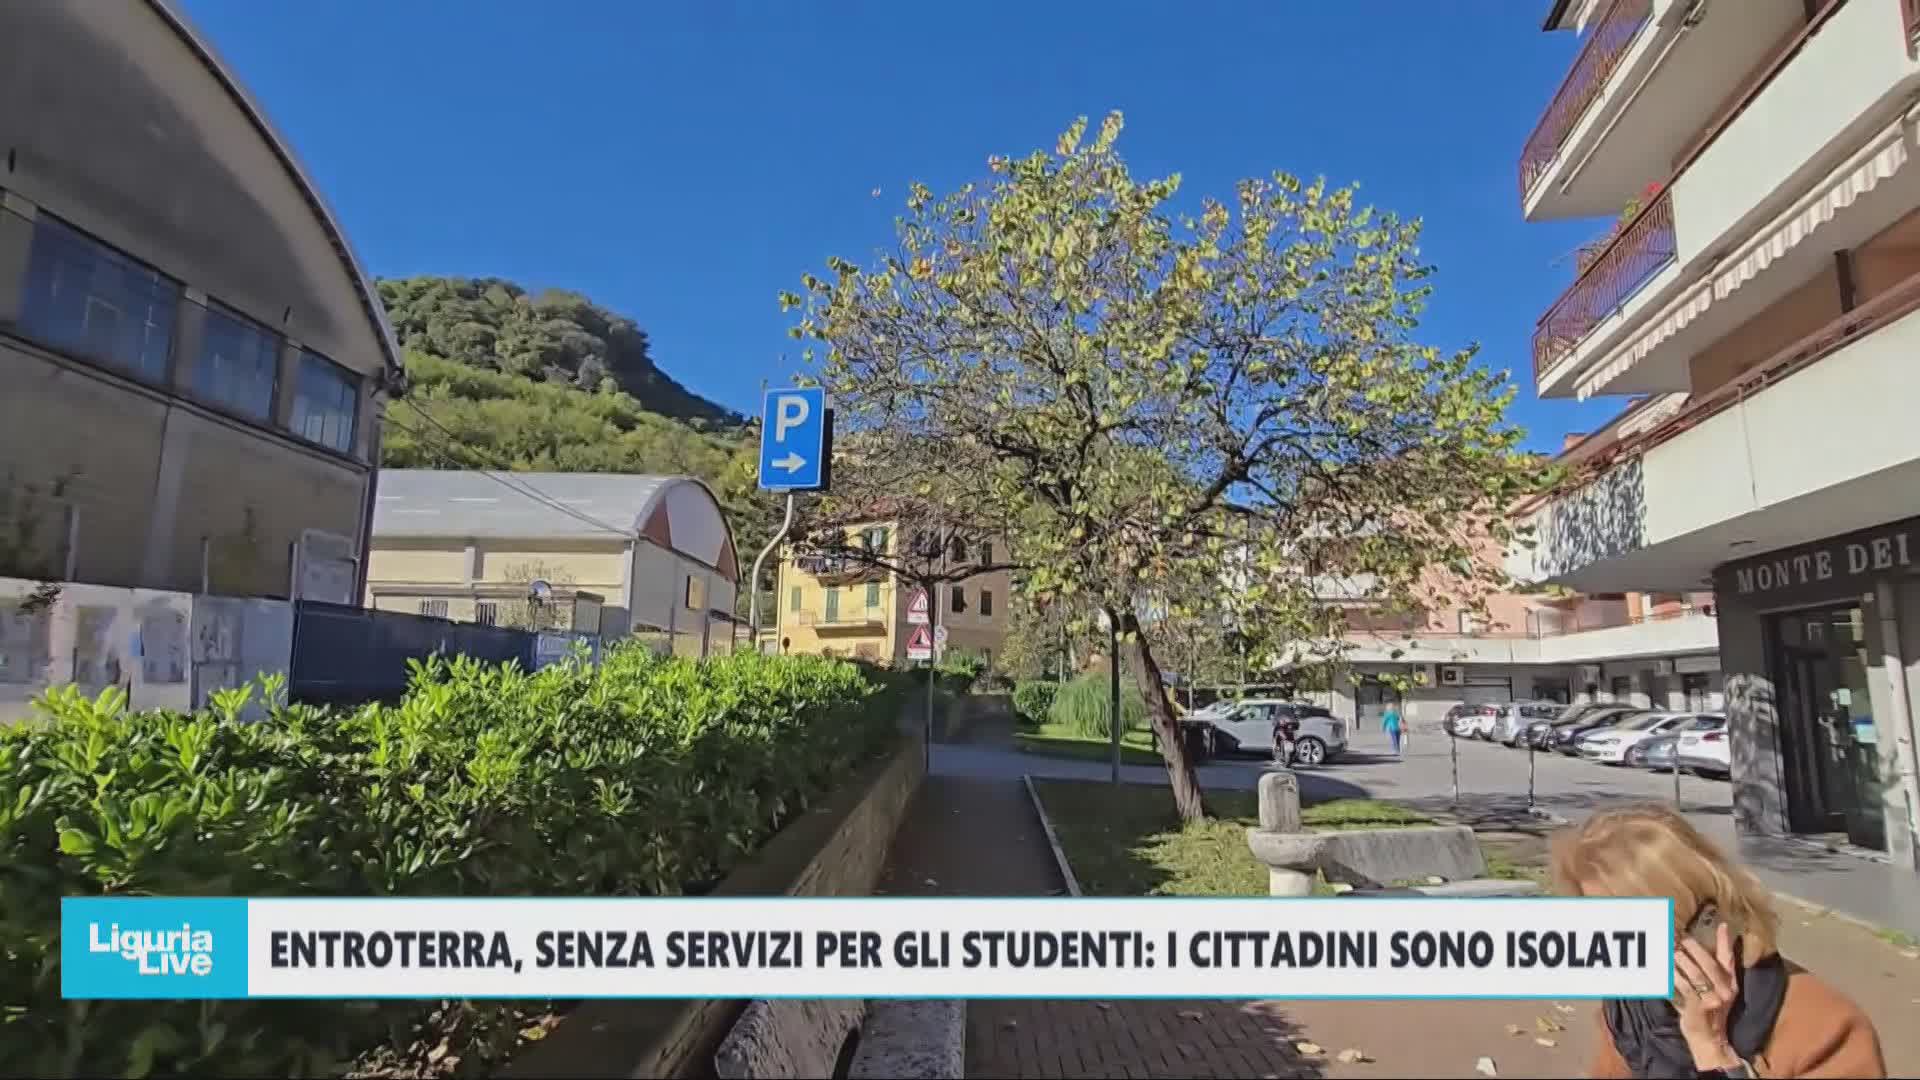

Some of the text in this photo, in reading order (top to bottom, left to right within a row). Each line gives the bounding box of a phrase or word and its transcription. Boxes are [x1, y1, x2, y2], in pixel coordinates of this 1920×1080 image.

[775, 396, 809, 442] P
[1736, 533, 1911, 593] MONTE DEI
